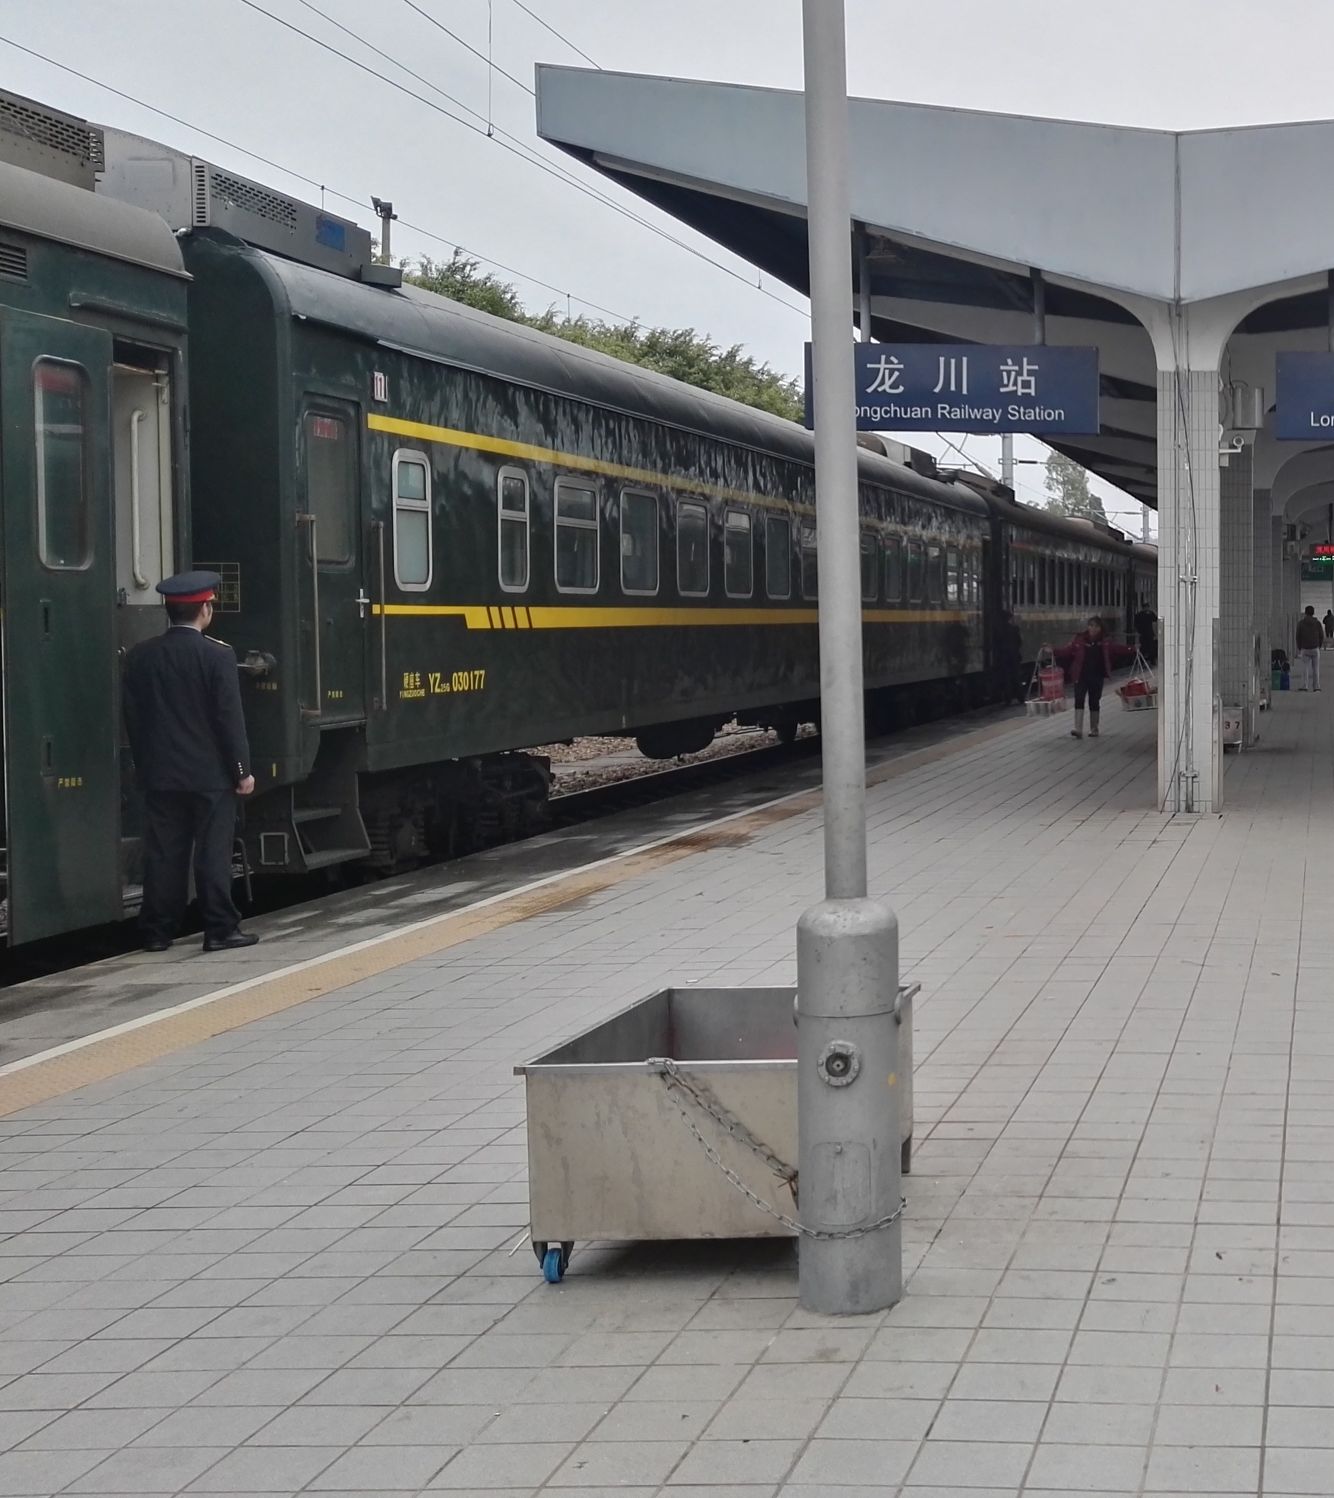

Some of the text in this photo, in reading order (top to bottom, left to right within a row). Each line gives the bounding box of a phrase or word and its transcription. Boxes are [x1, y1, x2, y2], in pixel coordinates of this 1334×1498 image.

[865, 353, 1040, 397] 龙川站
[937, 404, 1002, 424] Railway
[1007, 406, 1065, 421] Station
[452, 670, 486, 692] 030177
